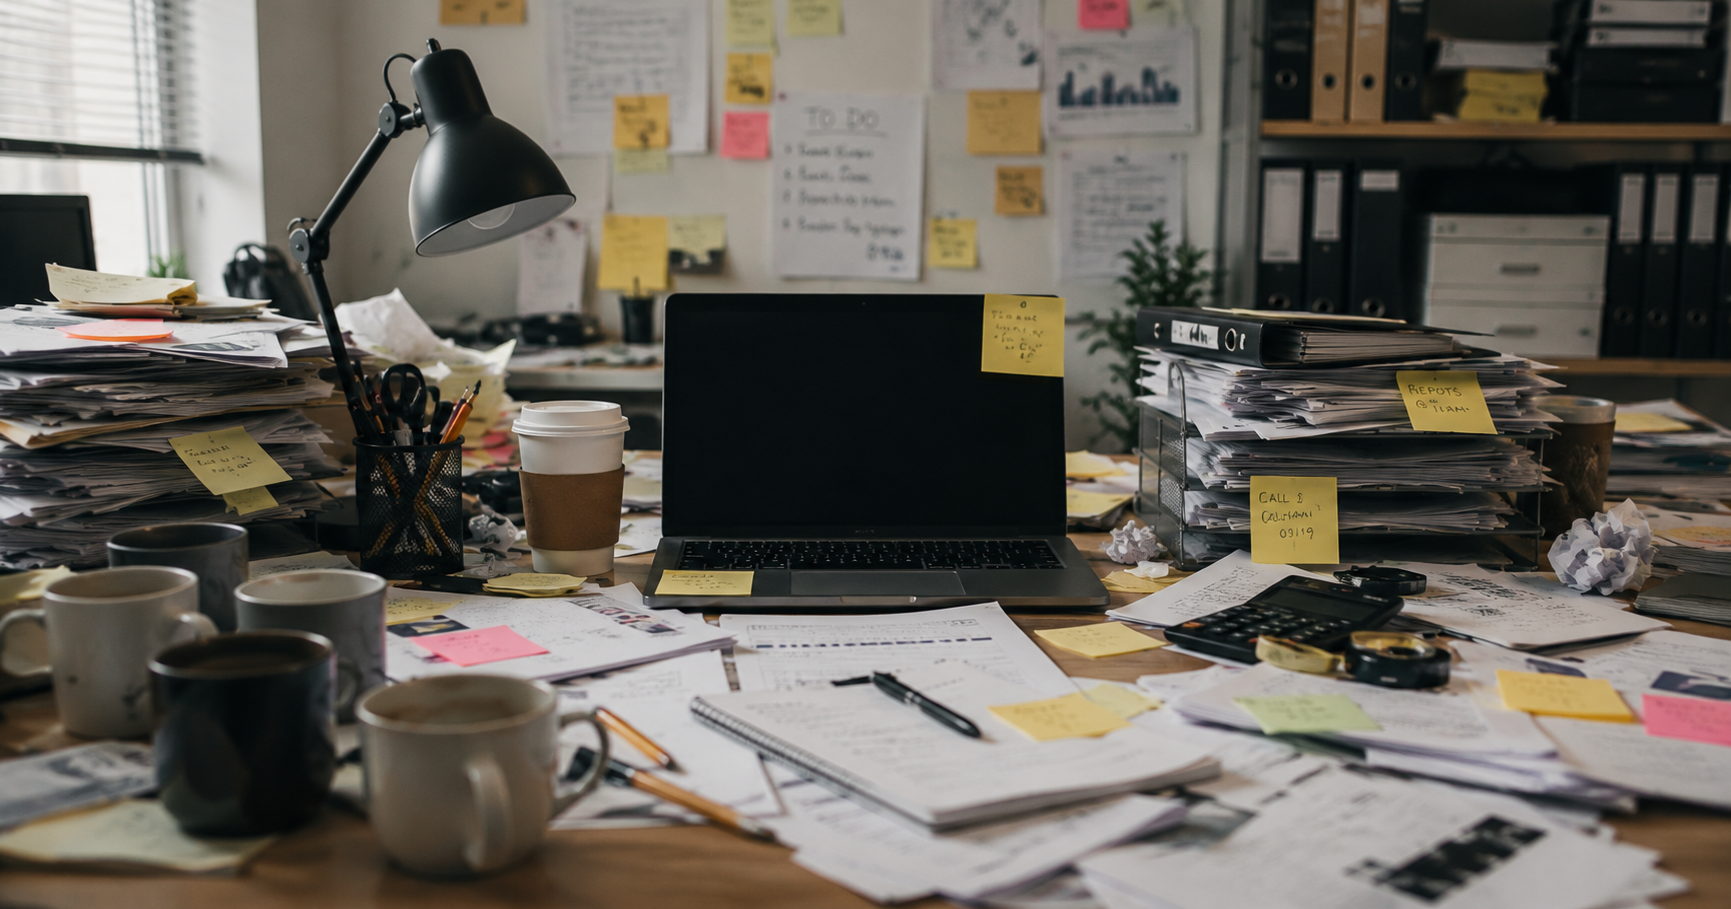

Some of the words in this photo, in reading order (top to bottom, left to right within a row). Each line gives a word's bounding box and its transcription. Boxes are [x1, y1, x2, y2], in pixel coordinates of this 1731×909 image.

[803, 105, 837, 130] TO
[846, 106, 880, 131] DO
[1407, 384, 1462, 397] REPOTS
[1259, 492, 1290, 503] CALL
